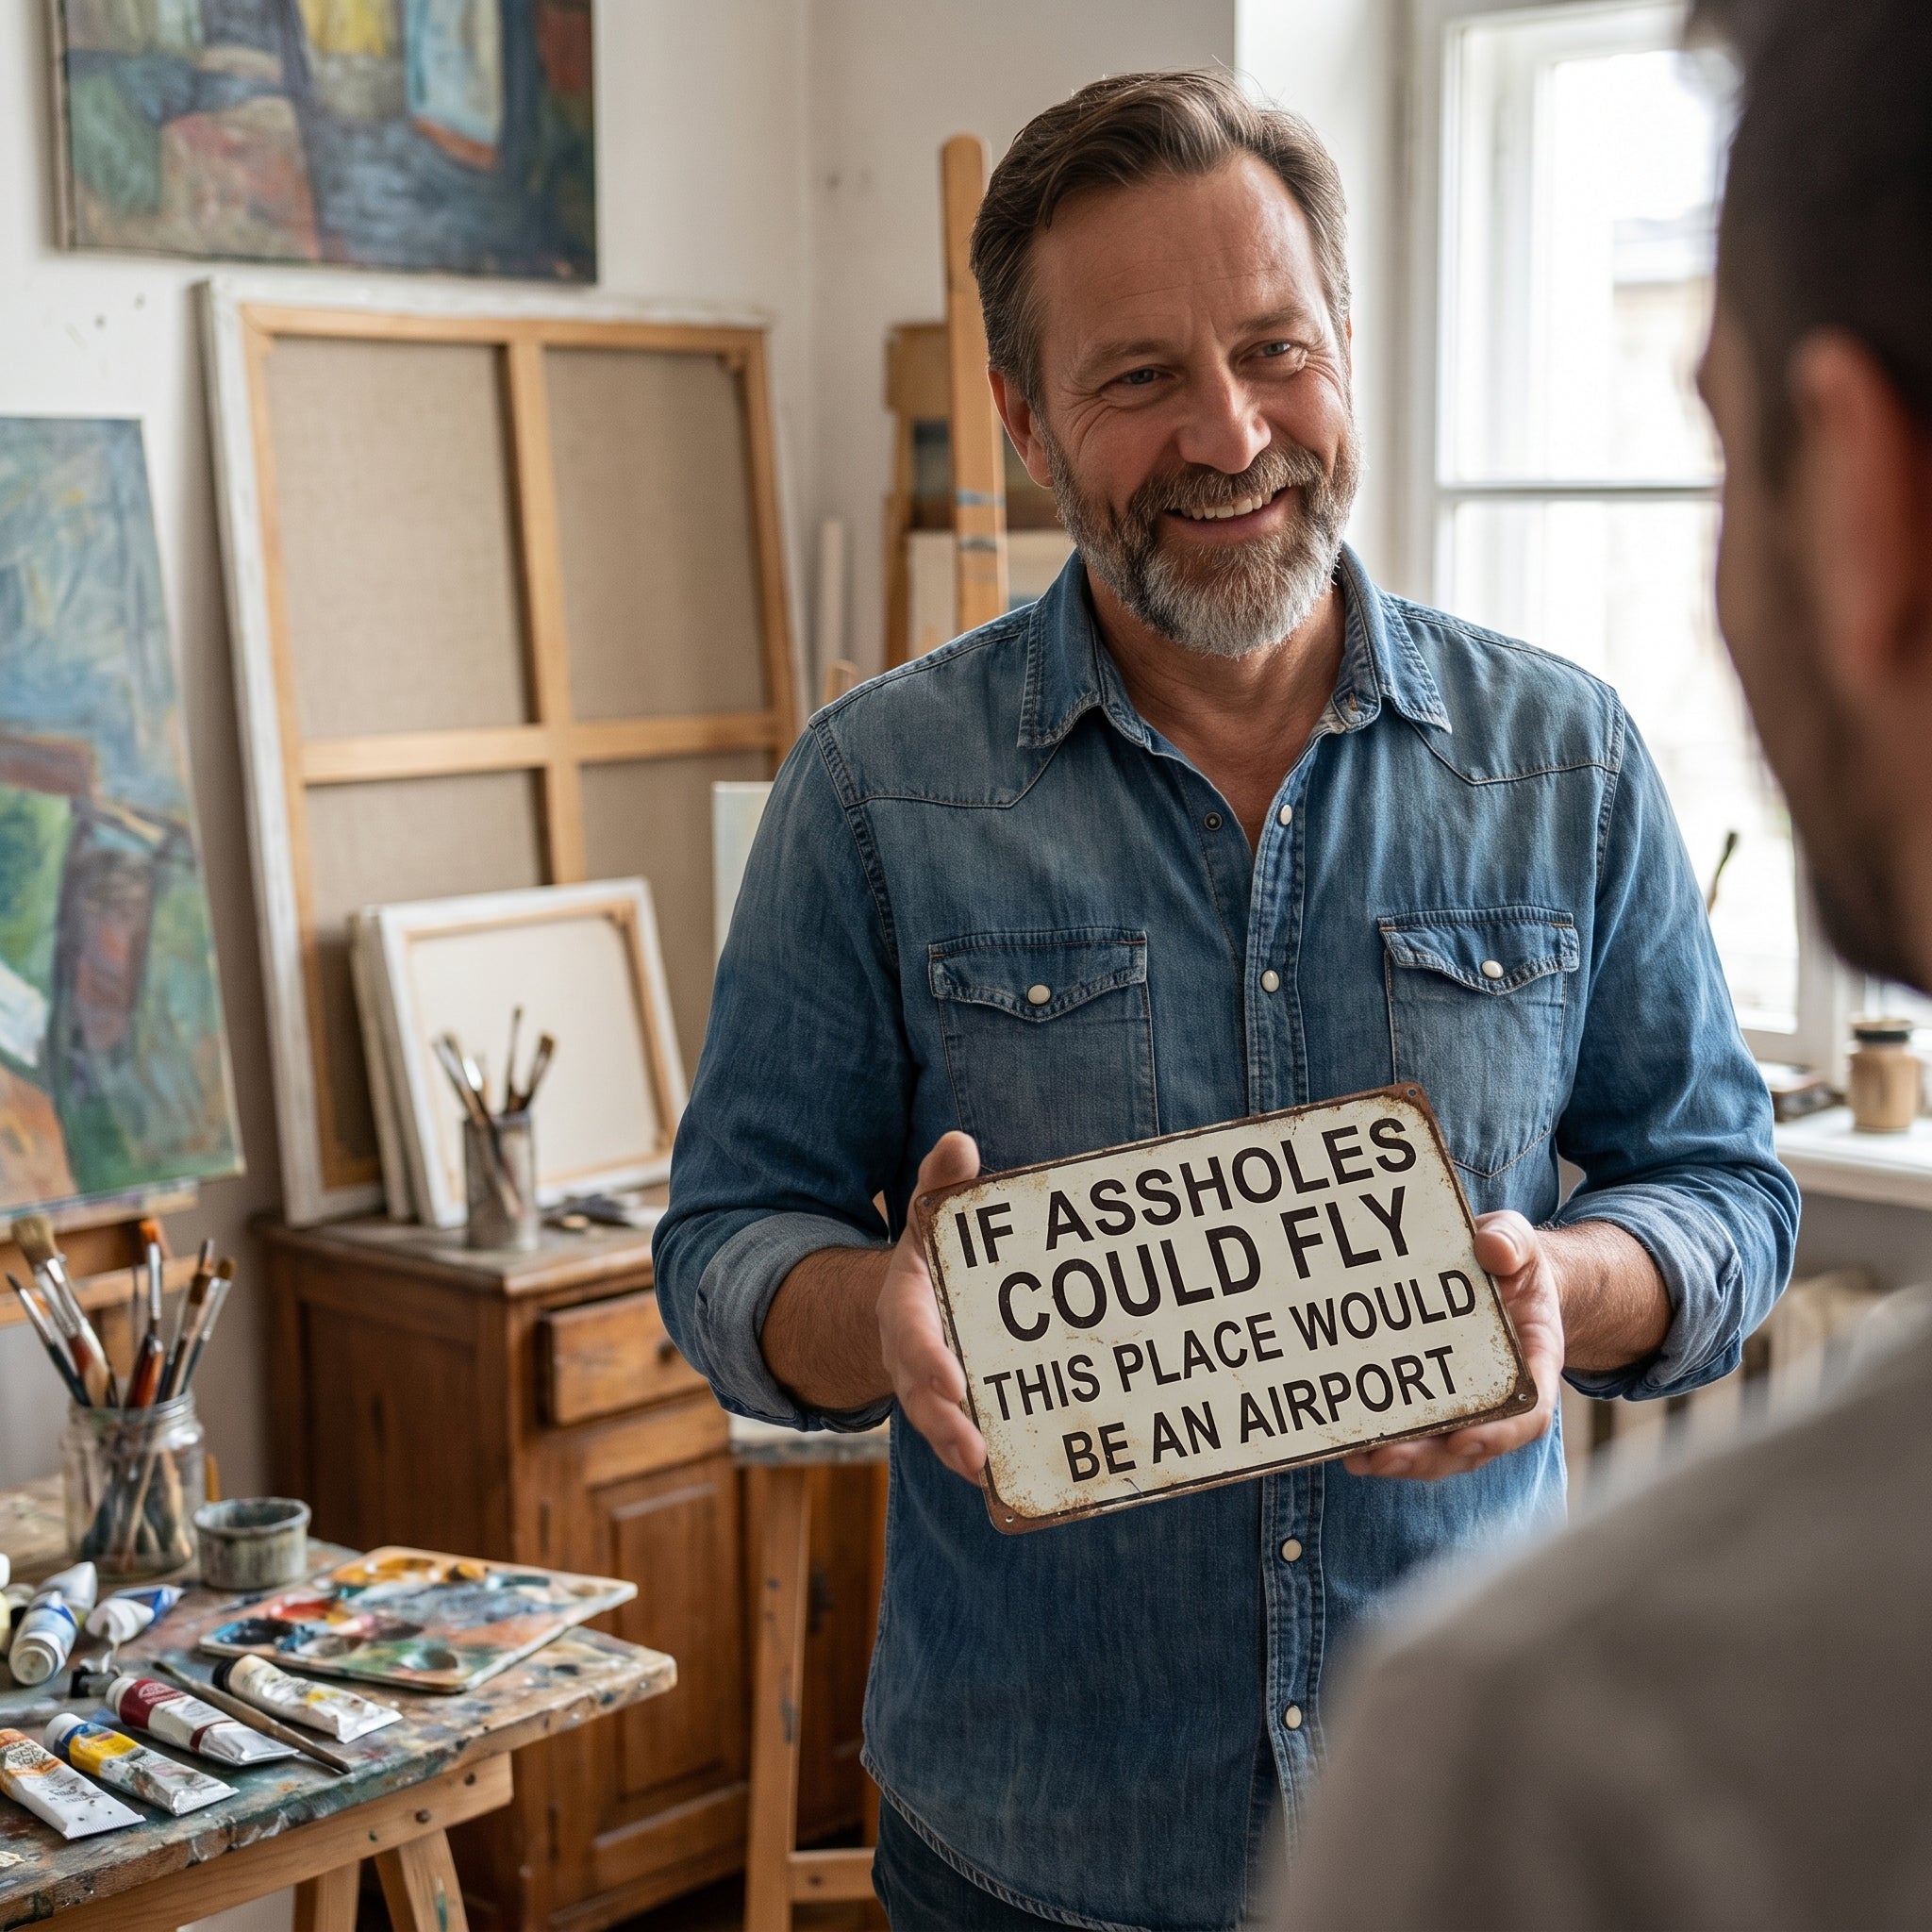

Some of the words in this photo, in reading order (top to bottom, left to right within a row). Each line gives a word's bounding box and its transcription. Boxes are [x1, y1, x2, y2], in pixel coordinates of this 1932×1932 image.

[955, 1202, 1013, 1269] IF
[1045, 1117, 1417, 1252] ASSHOLES
[997, 1224, 1261, 1342] COULD
[1279, 1185, 1409, 1280] FLY
[982, 1354, 1101, 1422] THIS
[1112, 1311, 1284, 1393] PLACE
[1288, 1269, 1476, 1352] WOULD
[1061, 1421, 1137, 1483] BE
[1152, 1400, 1222, 1465] AN
[1240, 1344, 1457, 1444] AIRPORT
